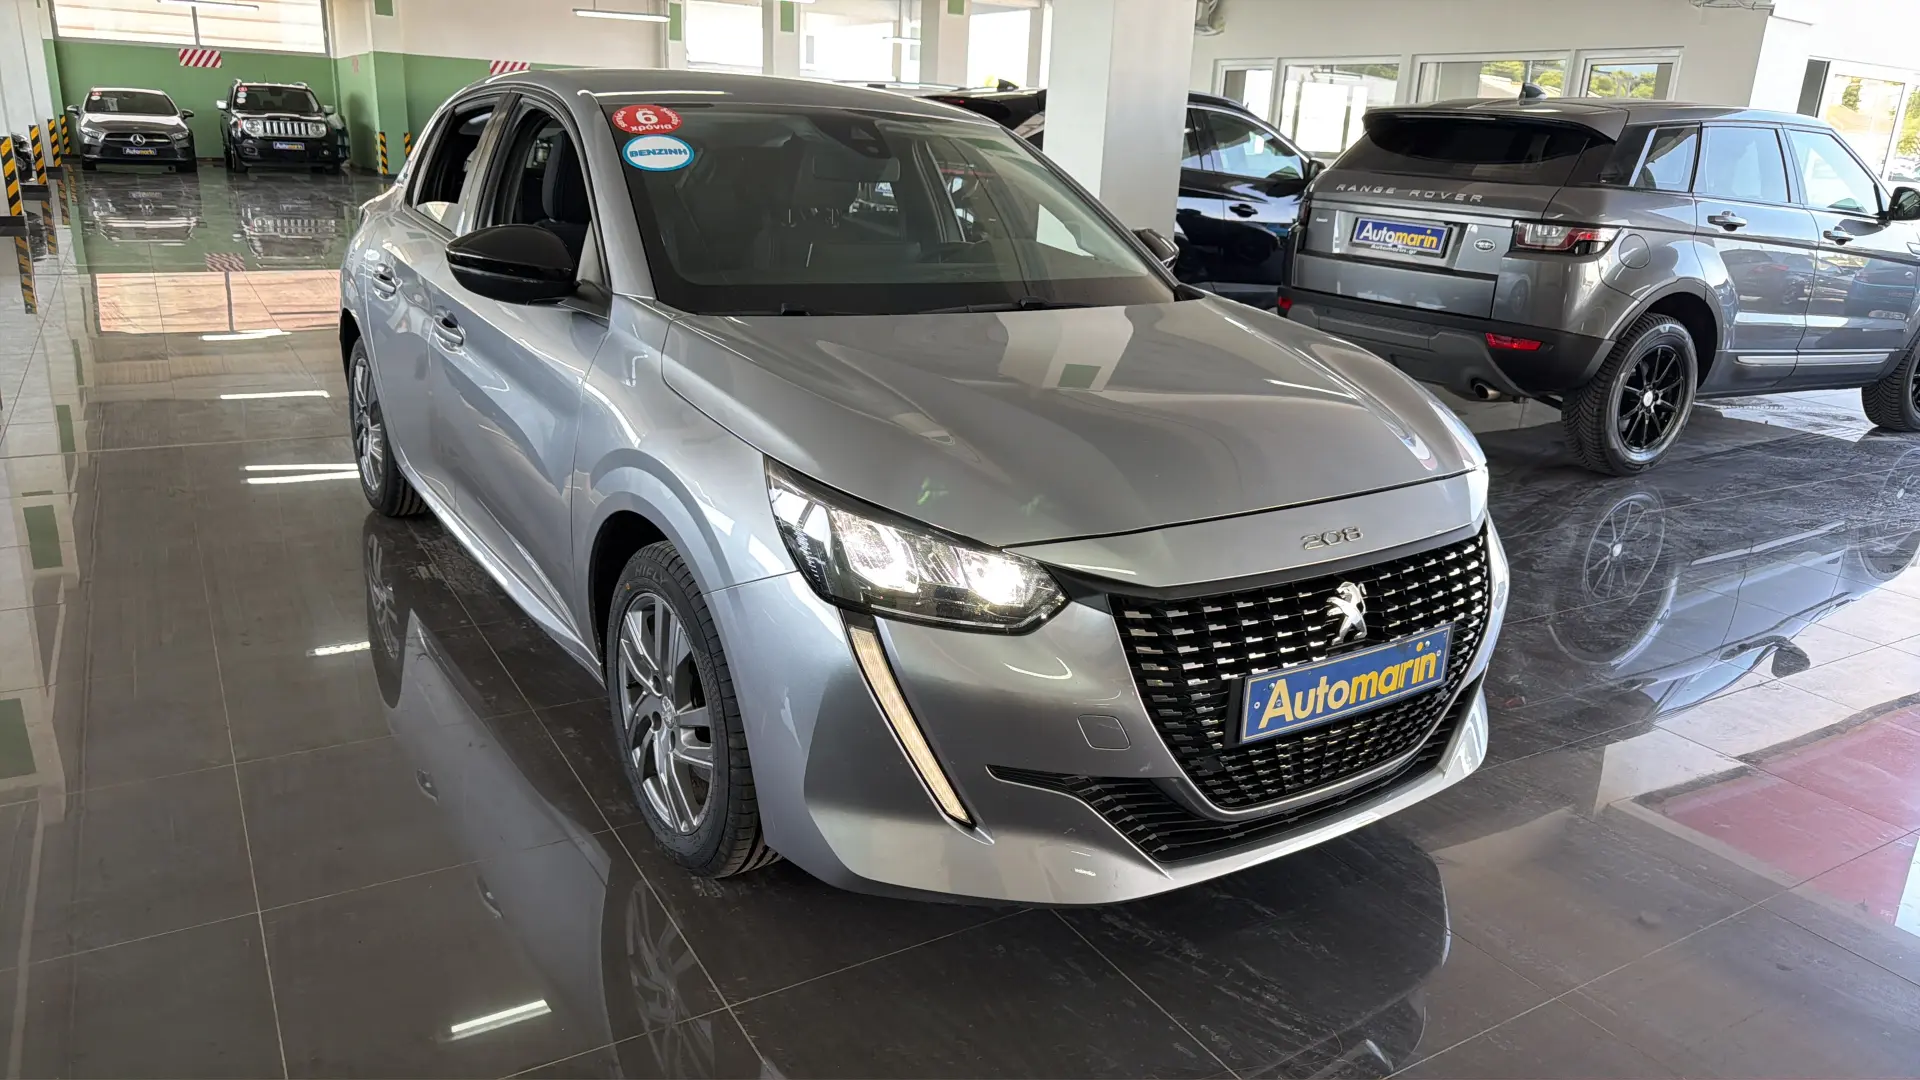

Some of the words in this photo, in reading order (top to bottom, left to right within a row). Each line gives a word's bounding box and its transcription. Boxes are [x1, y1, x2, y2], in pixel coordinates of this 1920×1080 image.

[630, 123, 673, 132] χρόνια
[636, 110, 659, 125] 6
[1336, 183, 1397, 195] RANGE
[1409, 189, 1484, 203] ROVER
[1359, 222, 1439, 249] Automarin
[1301, 526, 1364, 549] 208
[1258, 641, 1437, 729] Automarin
